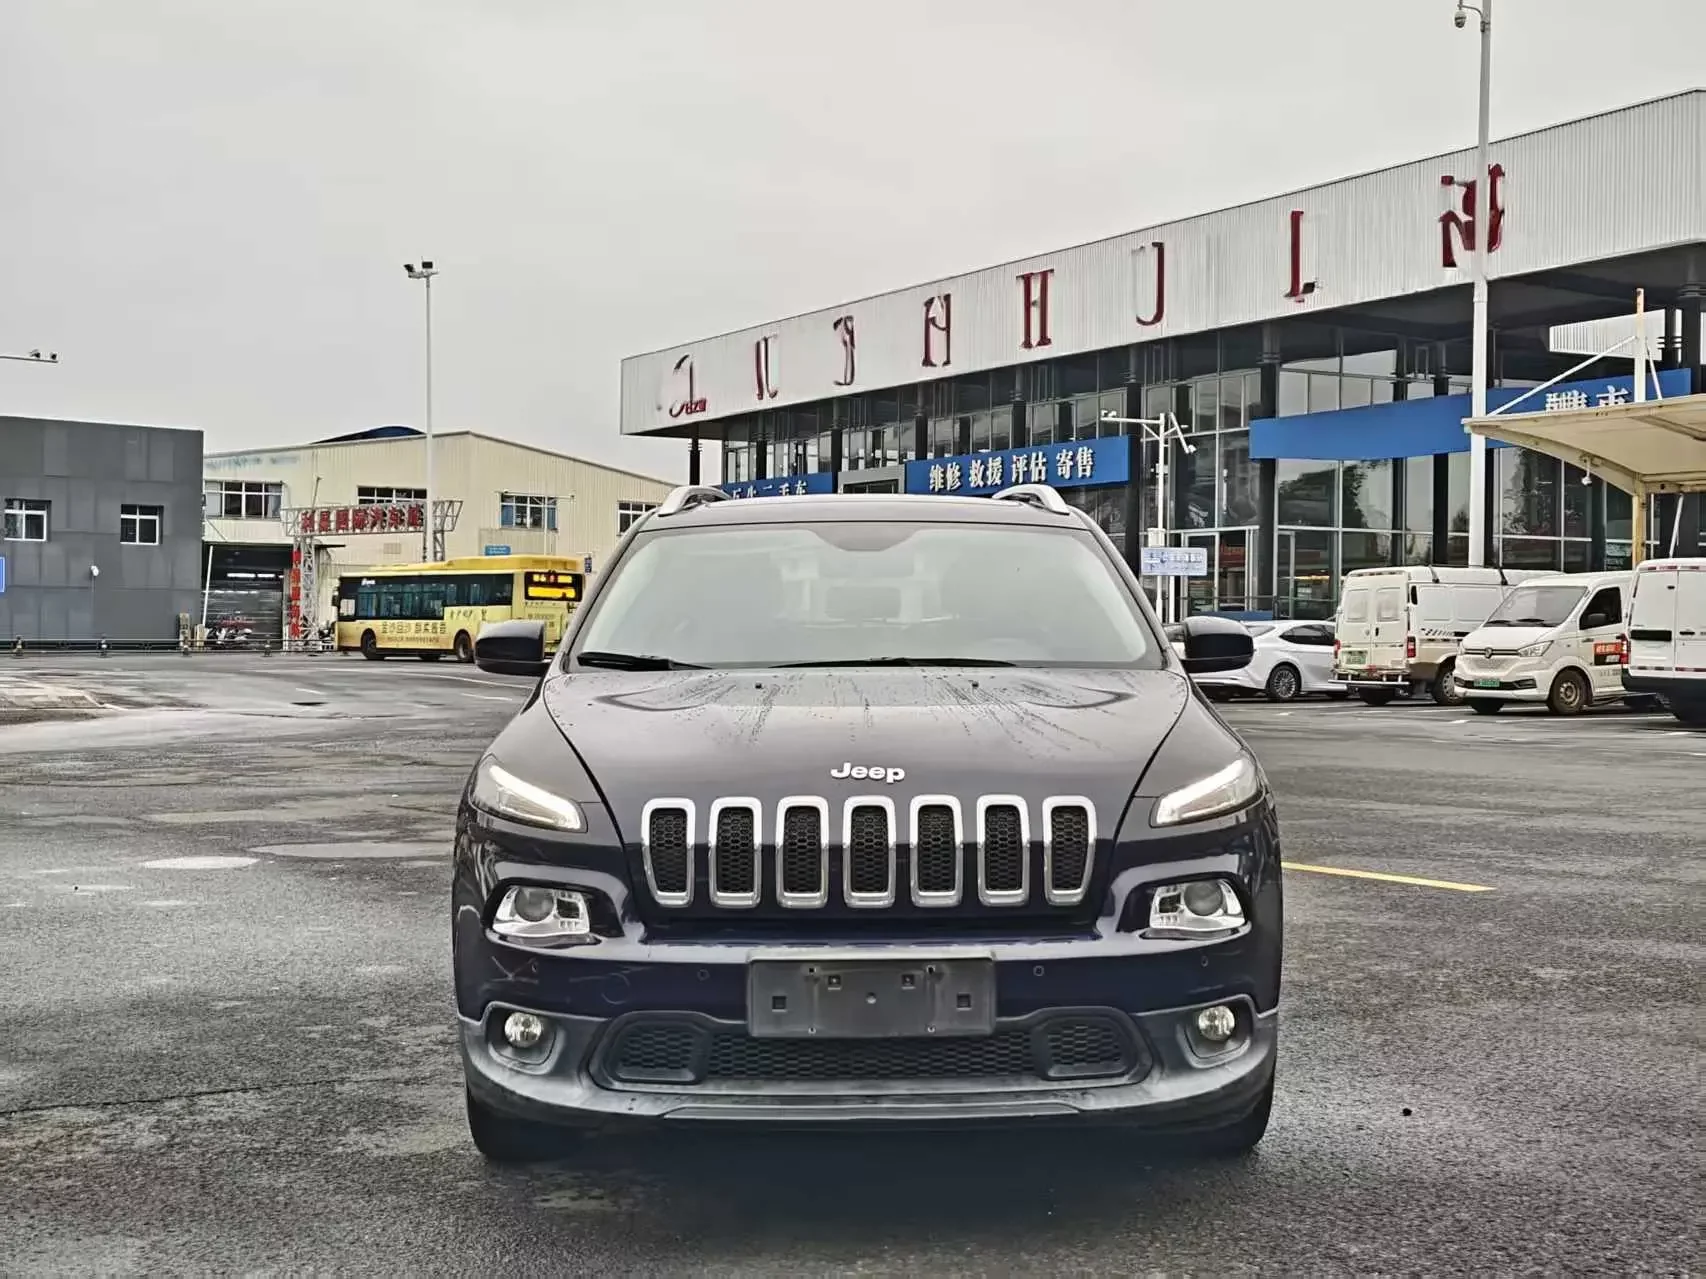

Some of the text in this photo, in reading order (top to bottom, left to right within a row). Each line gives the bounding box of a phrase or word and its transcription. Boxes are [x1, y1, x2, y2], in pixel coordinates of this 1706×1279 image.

[929, 446, 1094, 492] 维修 救援 评估 寄售
[830, 762, 905, 784] Jeep
